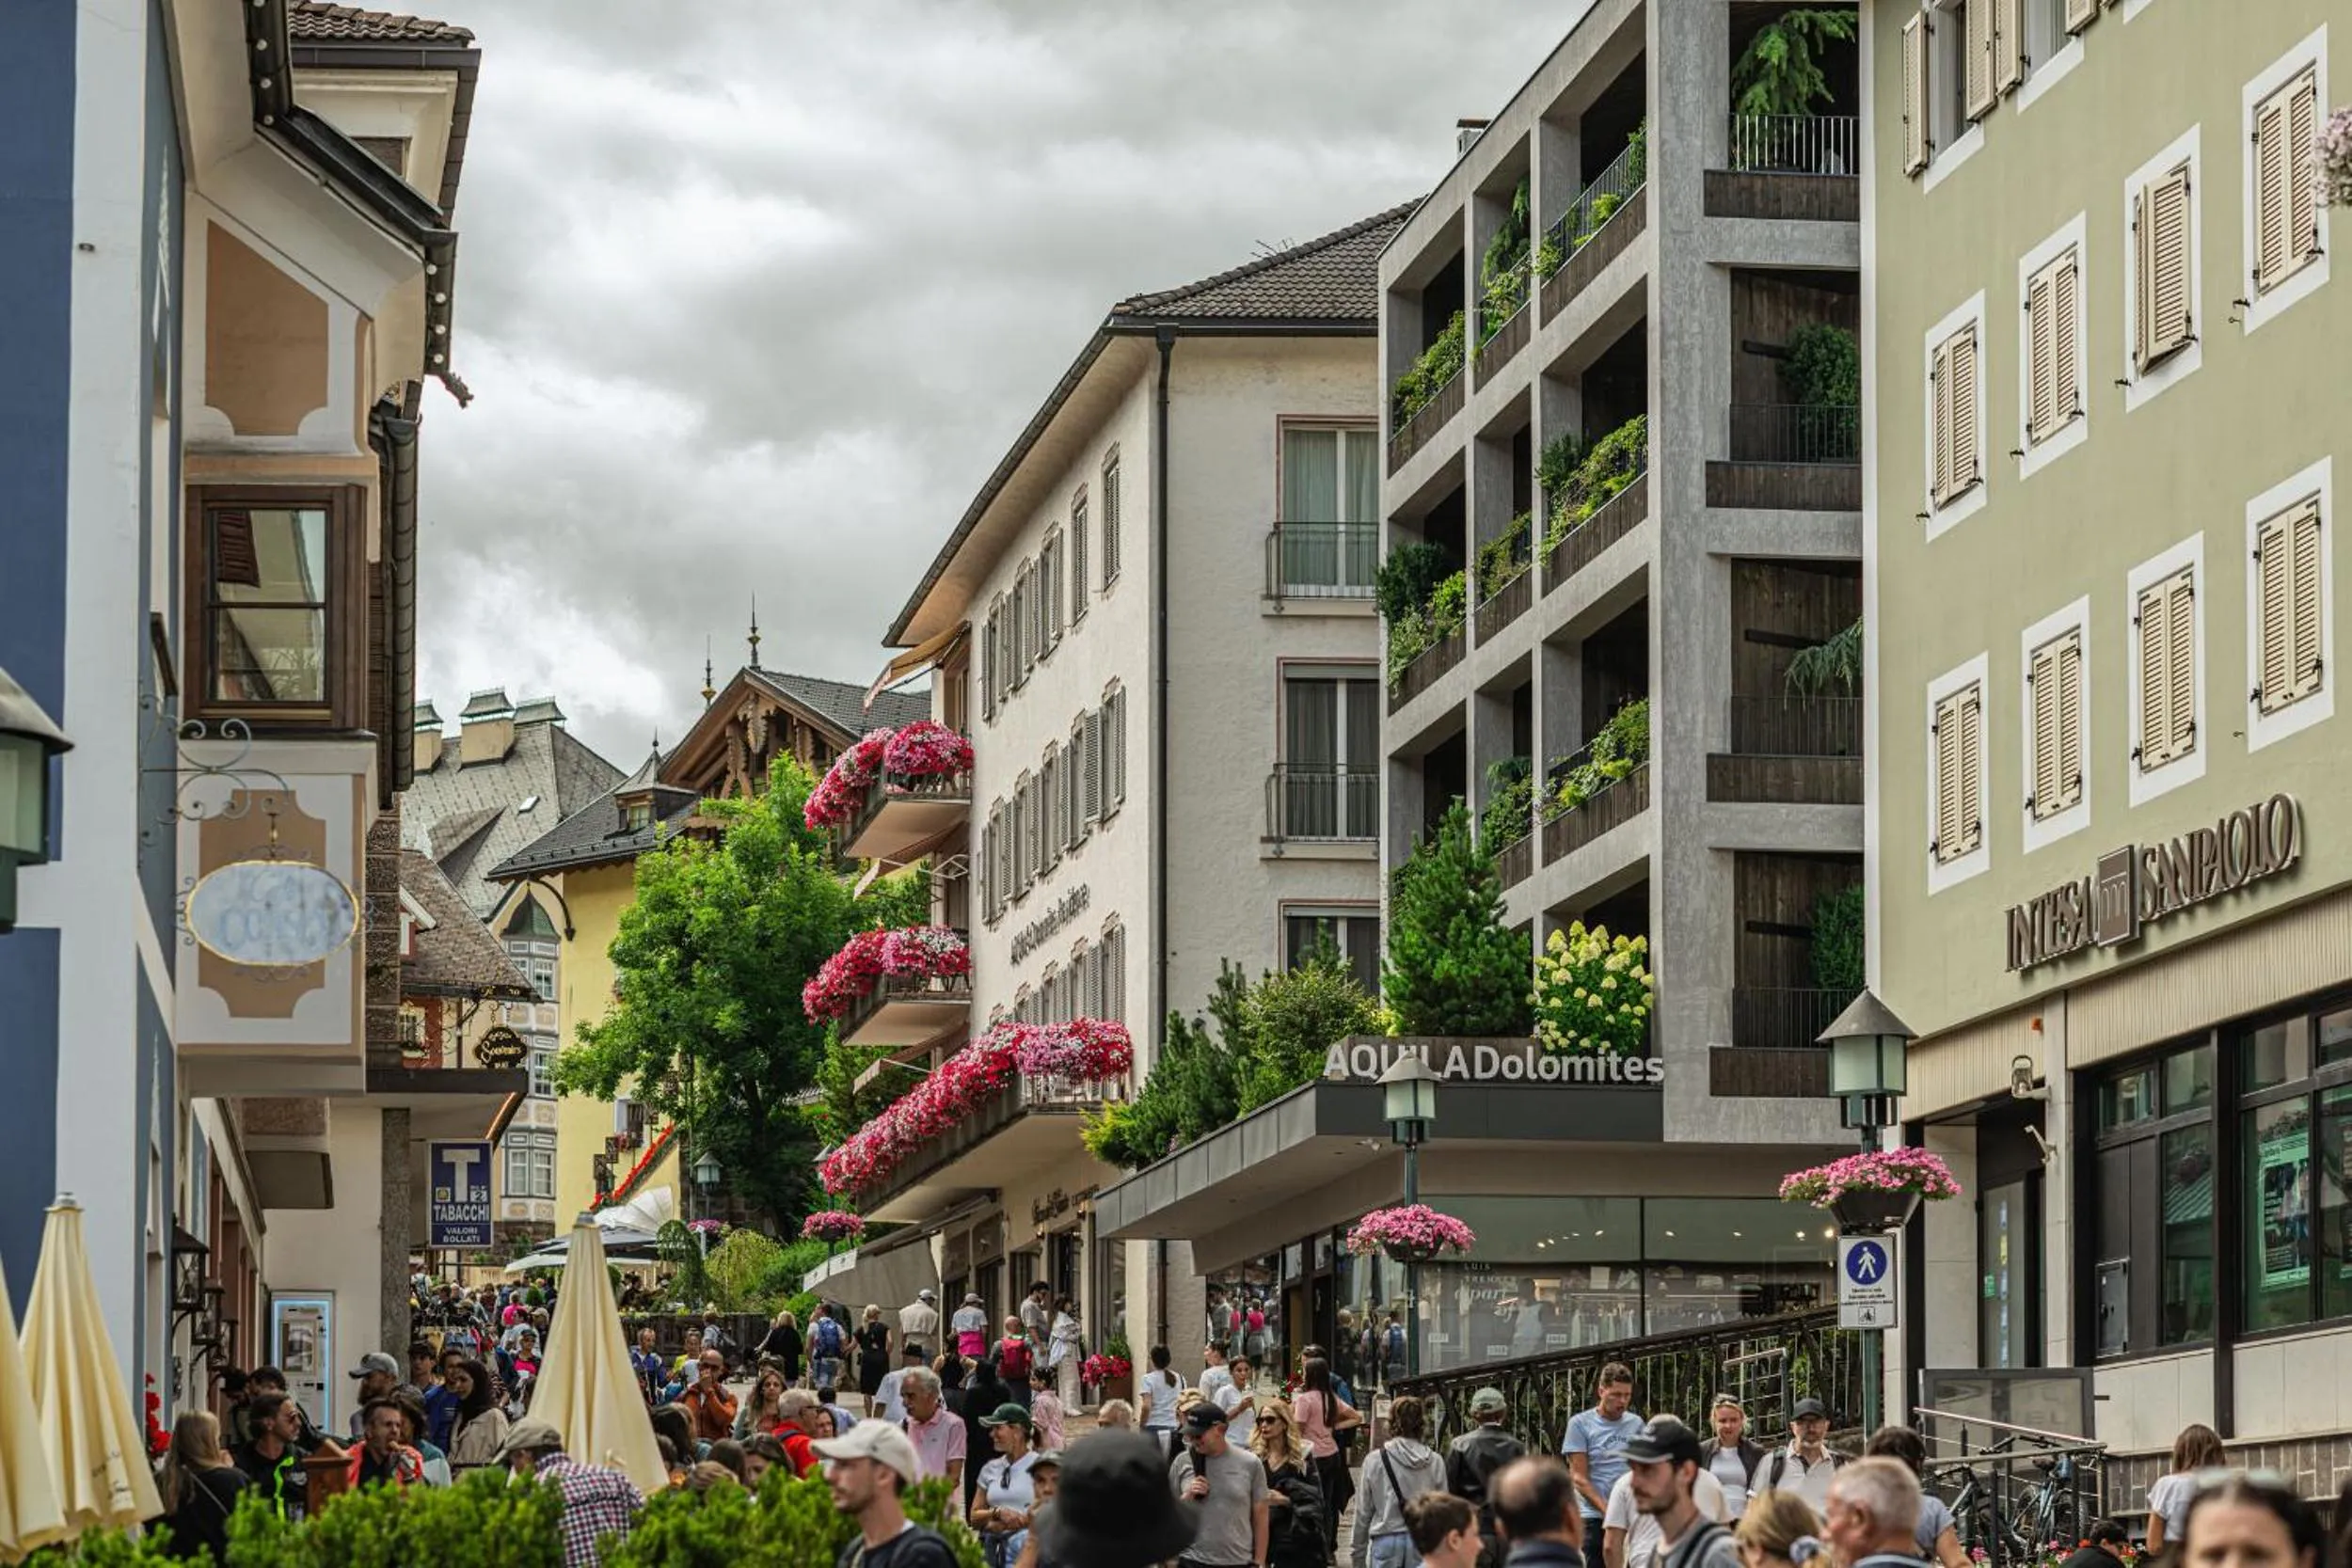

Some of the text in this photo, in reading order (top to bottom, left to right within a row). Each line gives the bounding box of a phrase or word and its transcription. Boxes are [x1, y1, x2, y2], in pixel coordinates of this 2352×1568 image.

[2005, 793, 2299, 973] INTESA SANPAOLO
[434, 1204, 490, 1221] TABACCHI
[445, 1227, 478, 1235] VALORI
